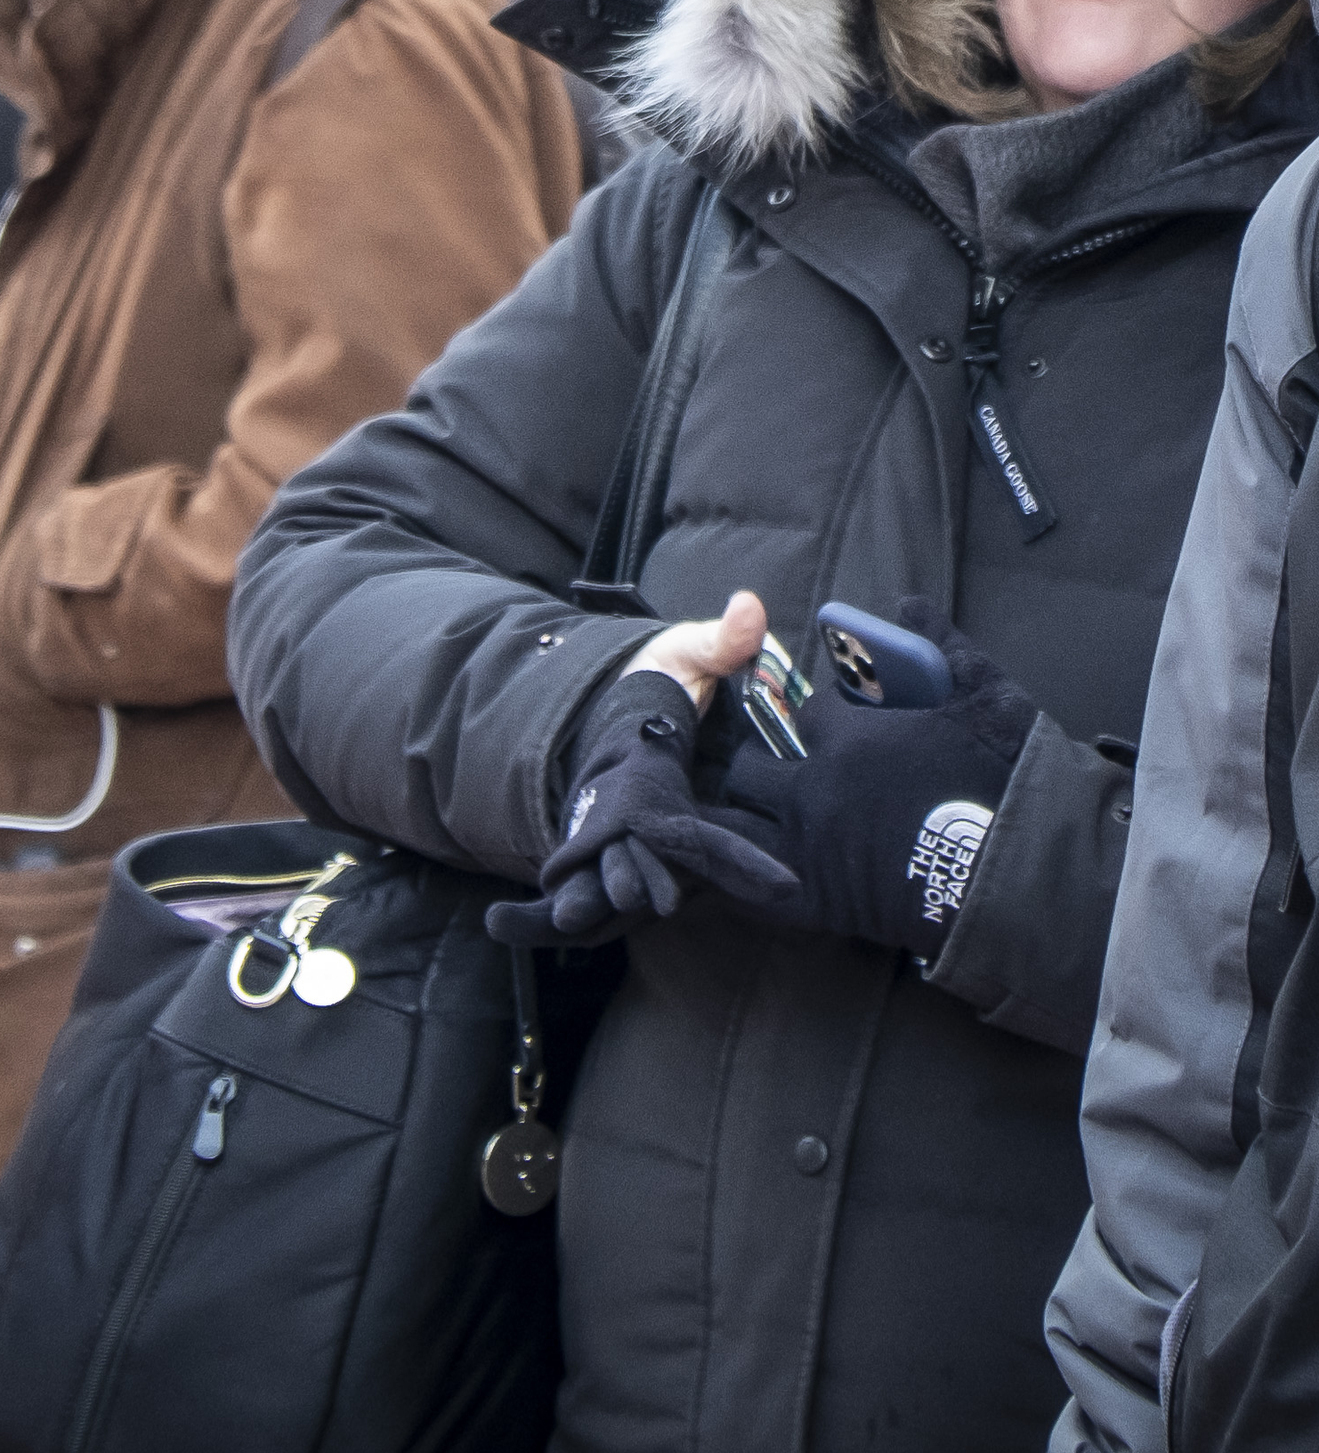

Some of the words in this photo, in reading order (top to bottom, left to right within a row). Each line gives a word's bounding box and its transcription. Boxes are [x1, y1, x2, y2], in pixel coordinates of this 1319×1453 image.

[980, 405, 1011, 465] CANADA
[1004, 462, 1038, 515] GOOSE
[907, 829, 940, 880] THE
[923, 839, 958, 924] NORTH
[944, 847, 975, 909] FACE
